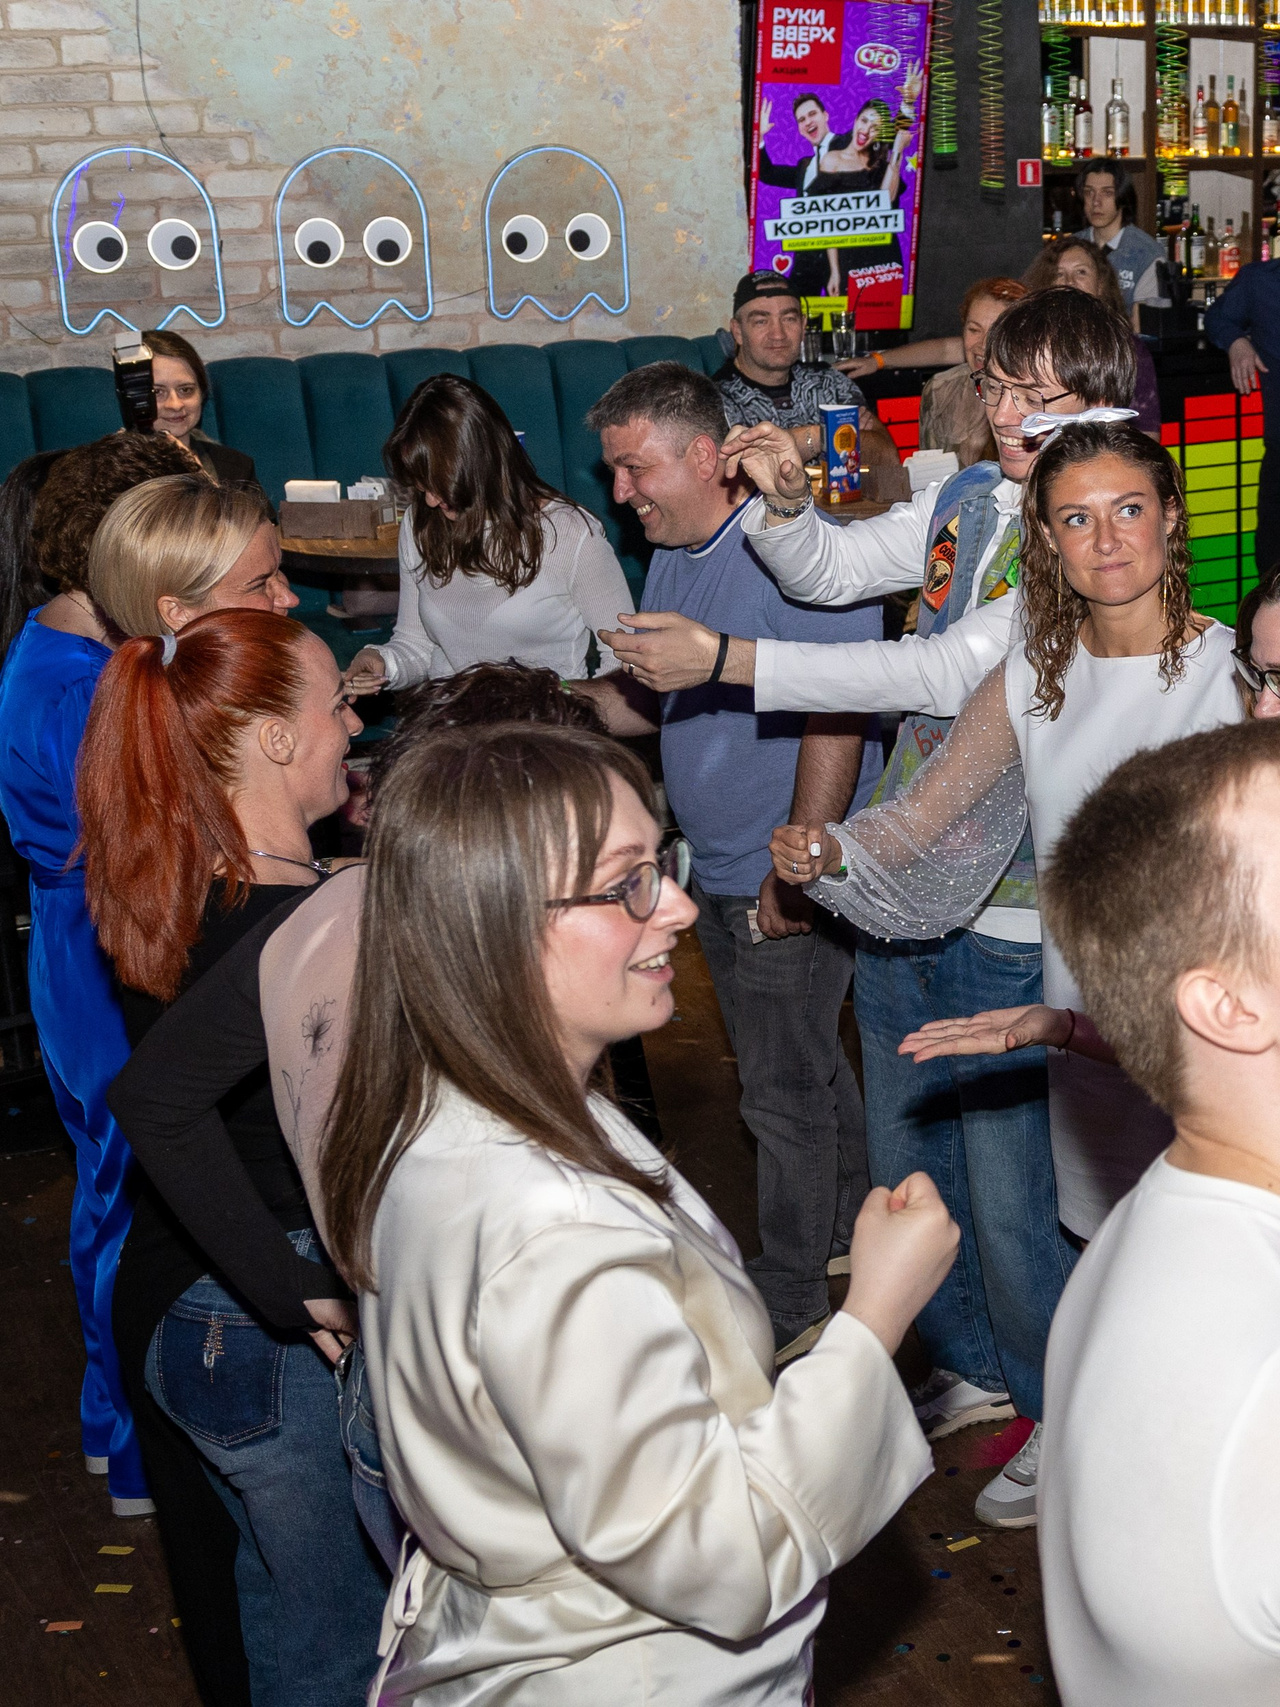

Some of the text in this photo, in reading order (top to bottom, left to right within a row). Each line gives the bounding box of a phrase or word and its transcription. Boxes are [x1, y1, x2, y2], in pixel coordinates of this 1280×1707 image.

[773, 8, 825, 25] РУКИ
[772, 25, 836, 43] ВВЕРХ
[771, 43, 811, 60] БАР
[859, 47, 899, 68] ОГО
[791, 194, 880, 215] ЗАКАТИ
[774, 214, 899, 237] КОРПОРАТ!
[848, 261, 903, 278] СКИДКА
[855, 276, 876, 289] ДО
